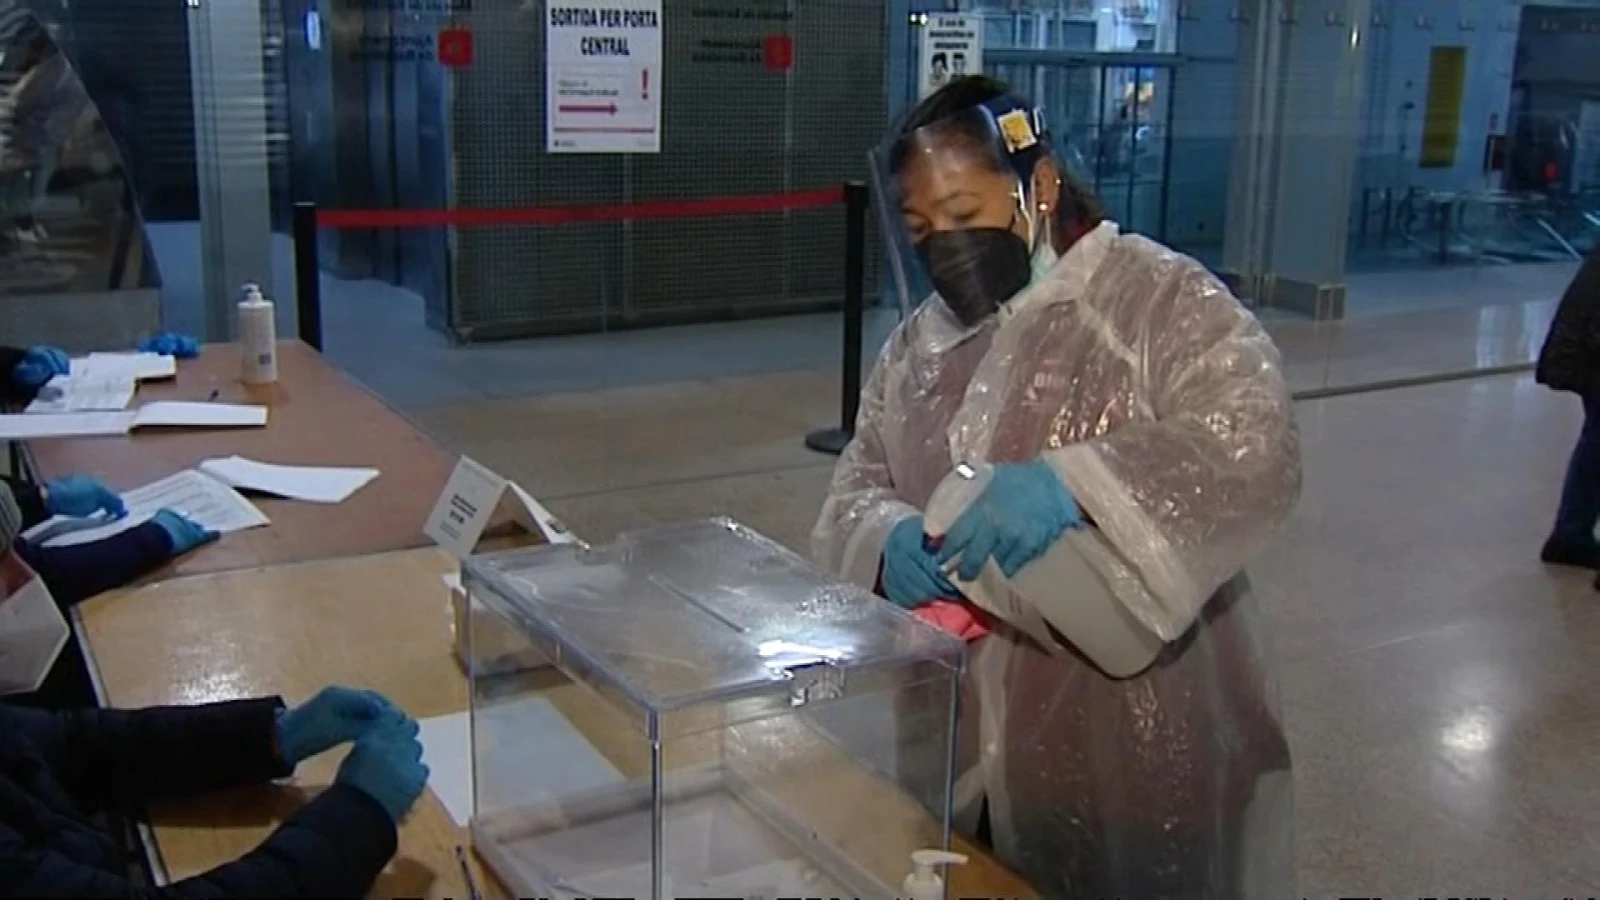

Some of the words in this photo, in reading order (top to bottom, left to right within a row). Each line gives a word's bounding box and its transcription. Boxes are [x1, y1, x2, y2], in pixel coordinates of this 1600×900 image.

[551, 8, 598, 27] SORTIDA
[601, 9, 621, 28] PER
[624, 10, 658, 28] PORTA
[581, 36, 631, 56] CENTRAL
